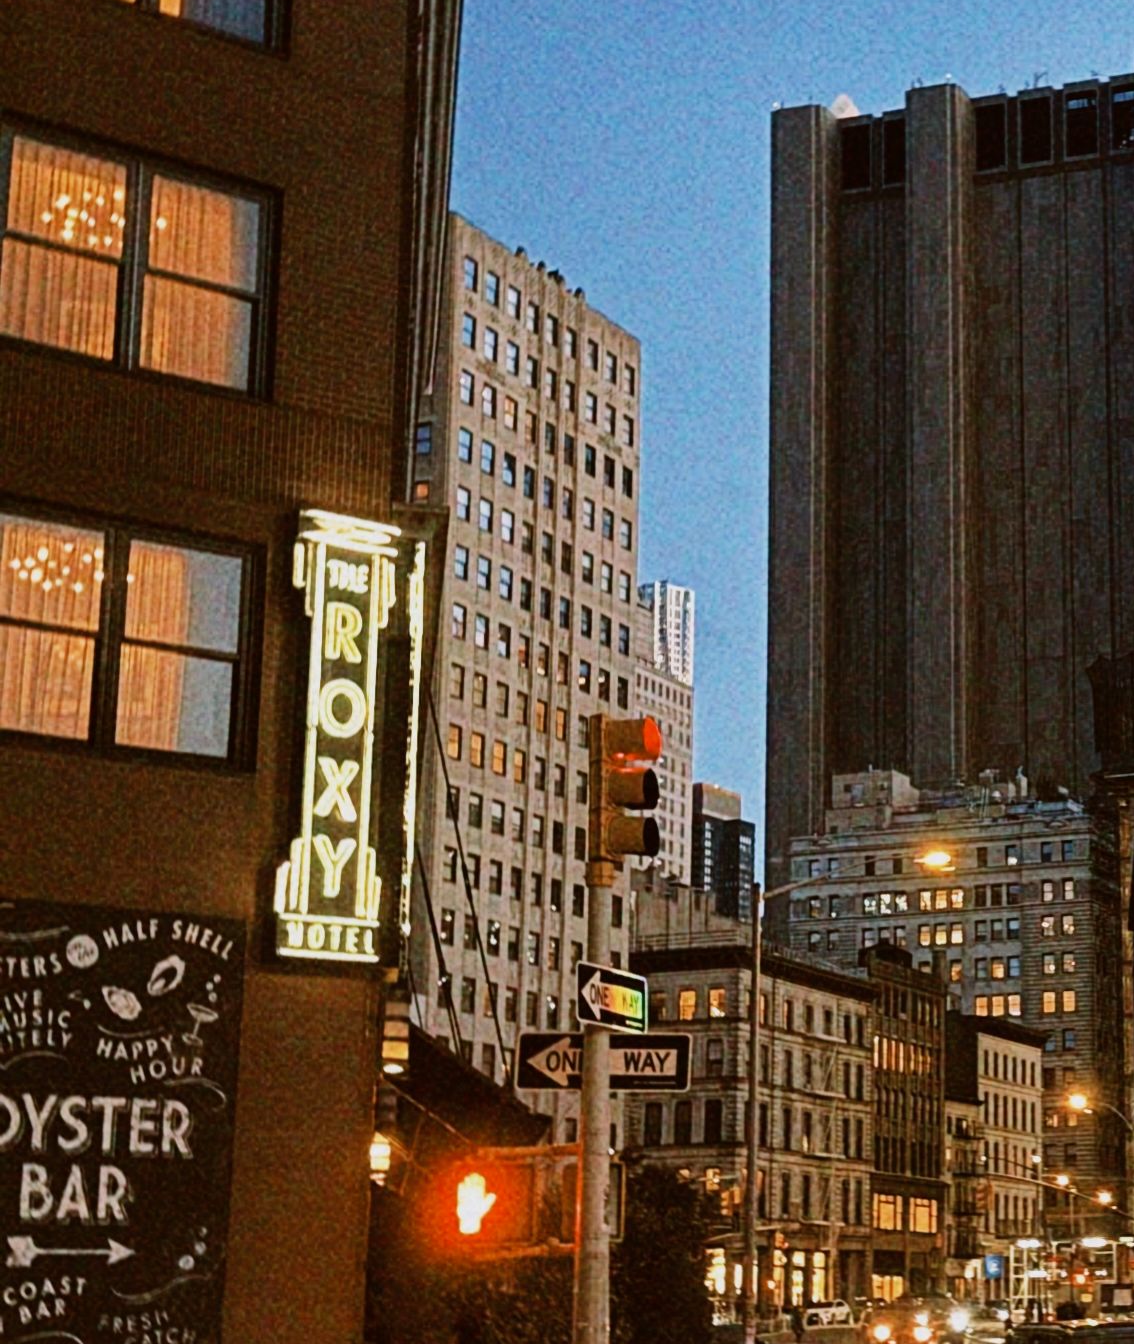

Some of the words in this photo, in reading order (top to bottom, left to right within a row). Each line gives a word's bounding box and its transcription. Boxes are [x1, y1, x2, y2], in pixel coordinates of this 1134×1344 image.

[326, 559, 369, 594] THE
[314, 602, 367, 898] ROXY
[102, 918, 159, 950] HALF
[172, 919, 234, 961] SHELL
[286, 922, 375, 954] HOTEL
[0, 952, 63, 978] TERS
[589, 983, 609, 1008] ONE
[0, 1028, 73, 1052] ITELY
[96, 1034, 173, 1061] HAPPY
[130, 1057, 204, 1084] HOUR
[545, 1052, 583, 1072] ON
[623, 1051, 671, 1073] WAY
[19, 1162, 133, 1225] BAR
[3, 1275, 87, 1306] COAST
[19, 1298, 66, 1325] BAR
[97, 1309, 170, 1334] FRESH
